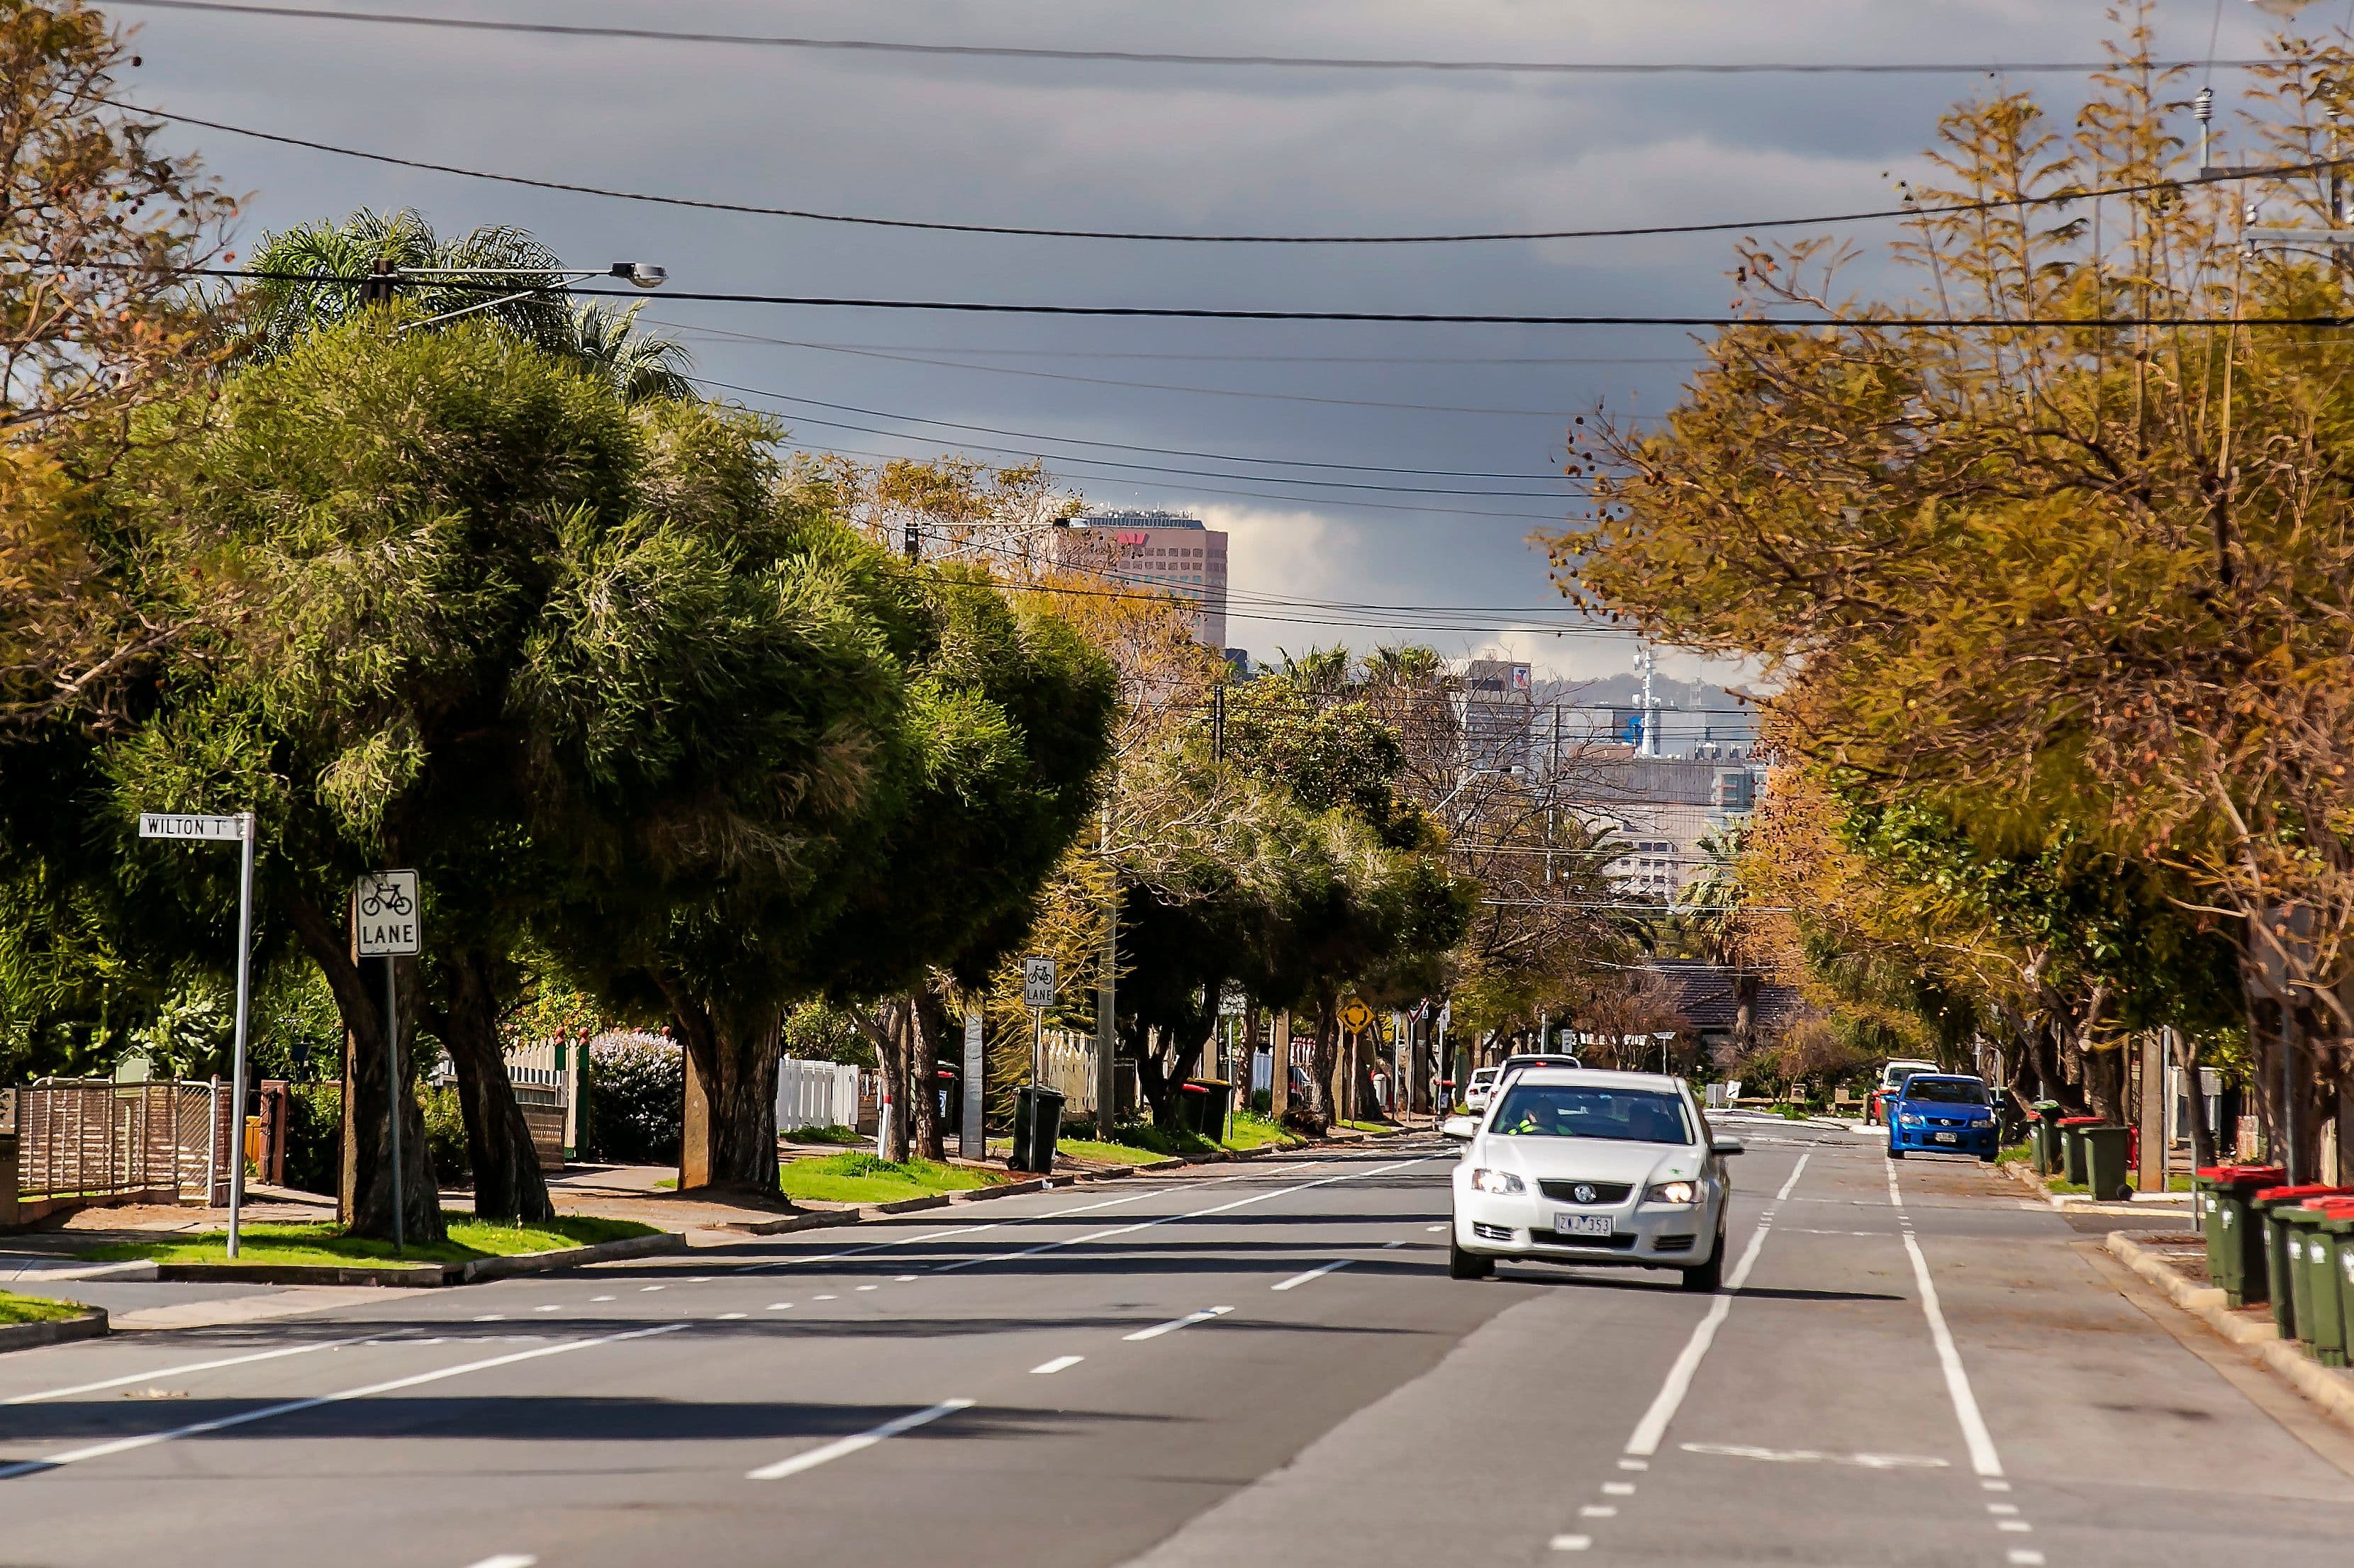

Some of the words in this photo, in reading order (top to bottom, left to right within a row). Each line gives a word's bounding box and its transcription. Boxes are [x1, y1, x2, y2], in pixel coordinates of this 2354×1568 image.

[148, 819, 204, 835] WILTON
[362, 924, 414, 944] LANE
[1027, 989, 1052, 1001] LANE
